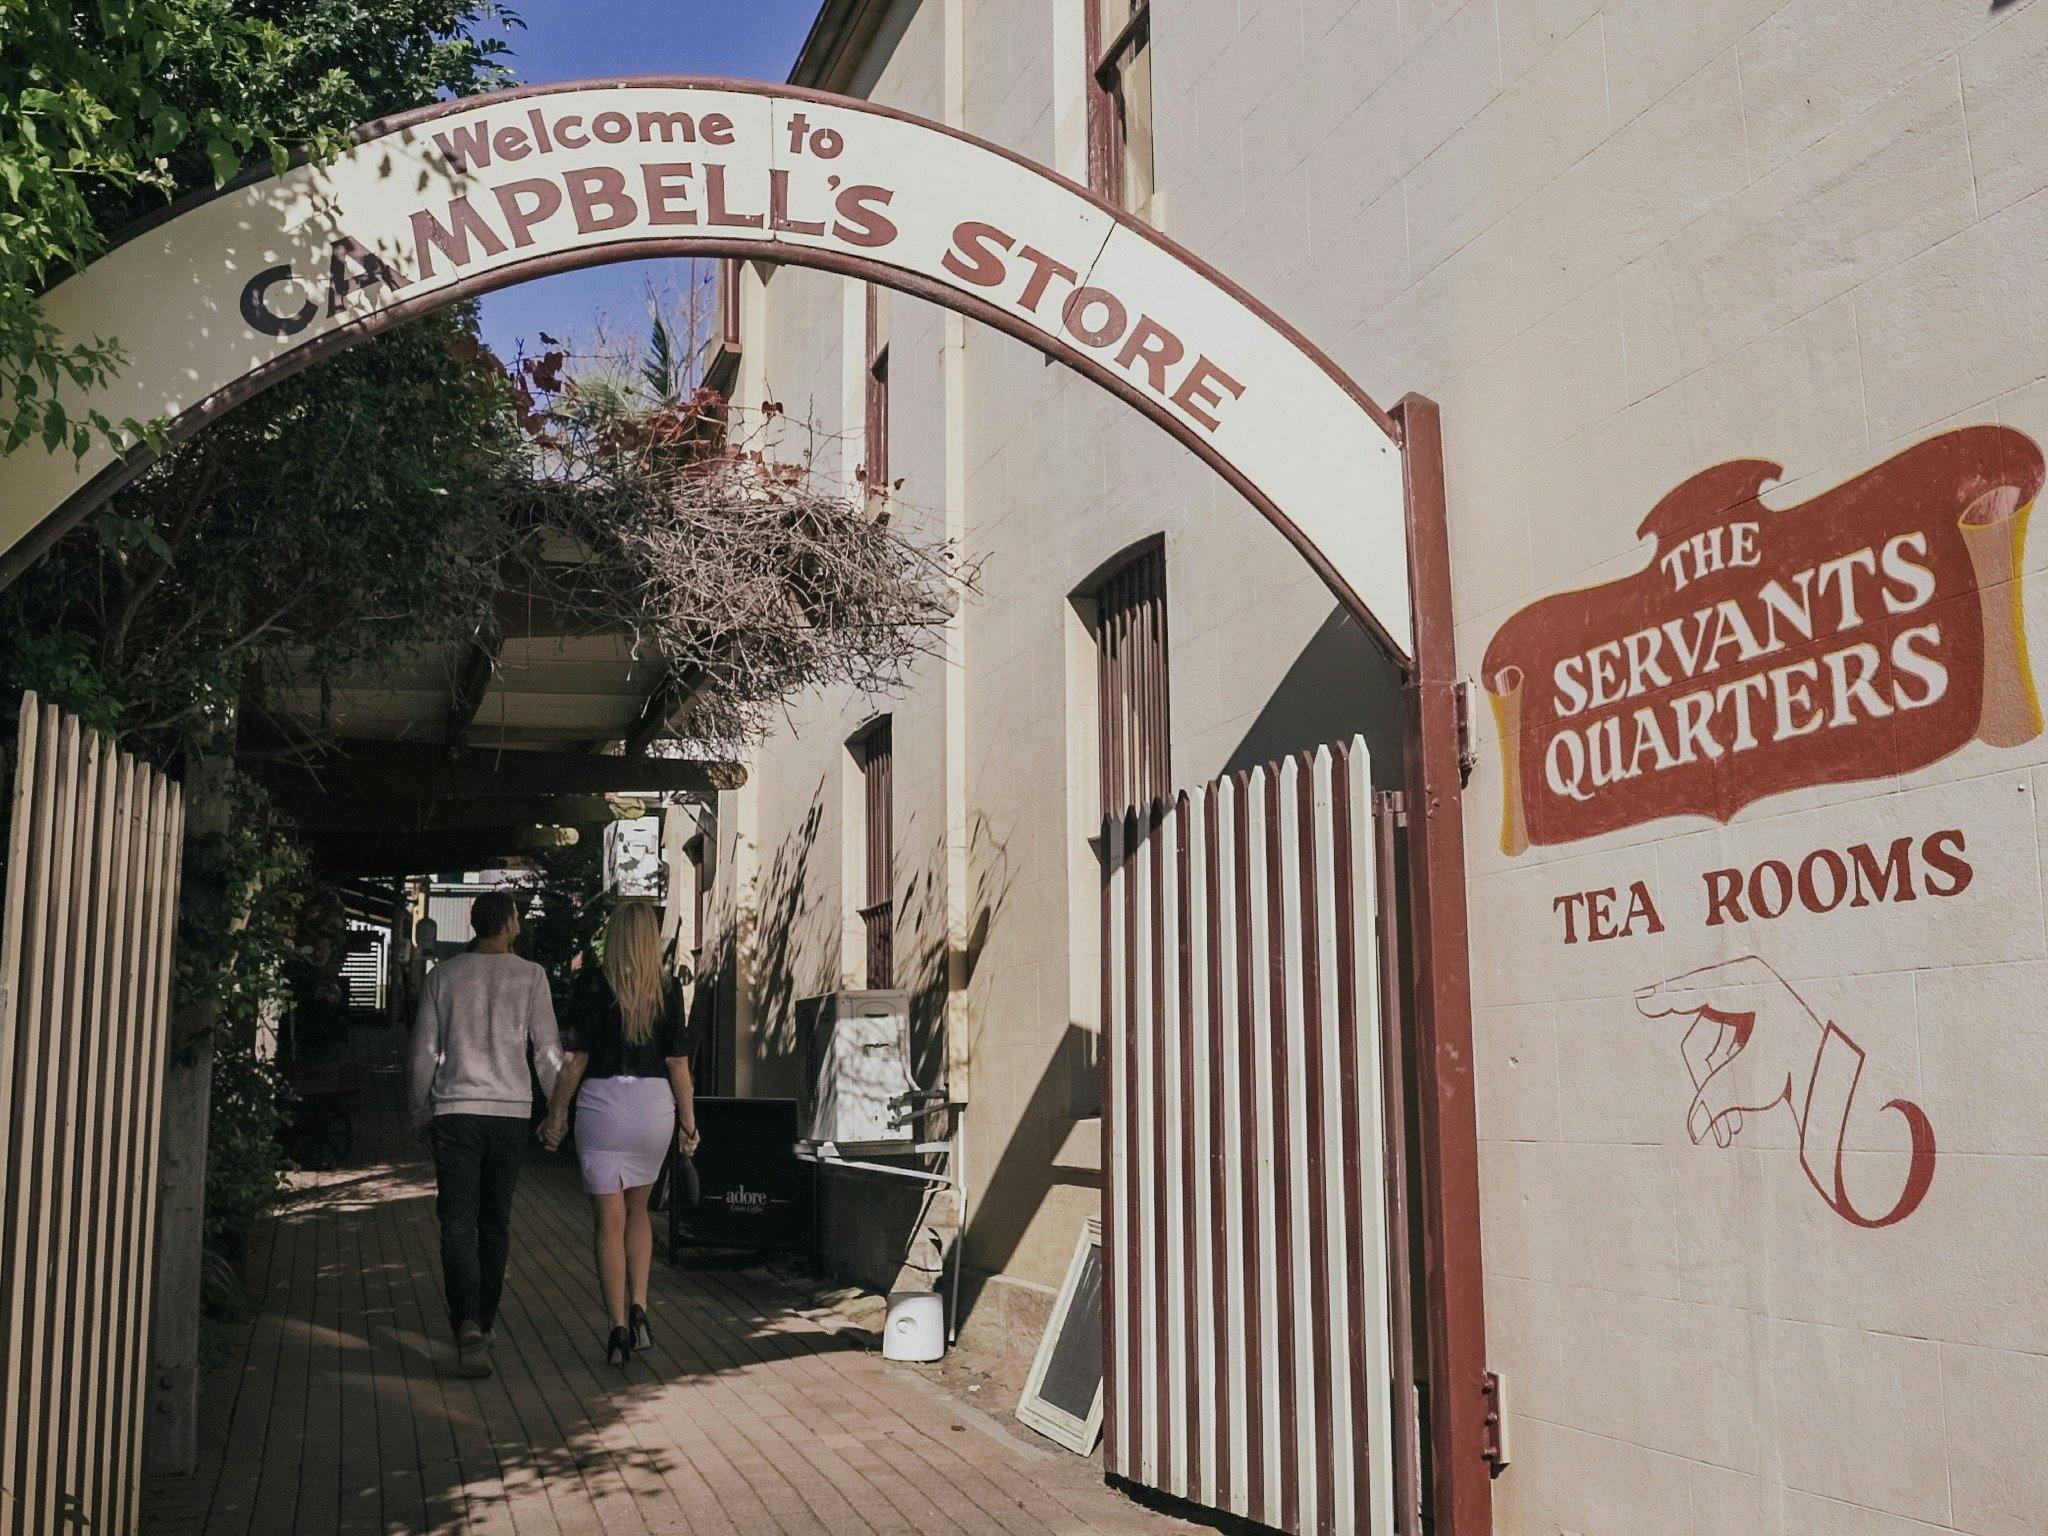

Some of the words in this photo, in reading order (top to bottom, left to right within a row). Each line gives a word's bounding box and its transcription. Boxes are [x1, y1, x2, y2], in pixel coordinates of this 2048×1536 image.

[433, 109, 735, 174] Welcome
[787, 113, 844, 159] to
[239, 163, 898, 336] CAMPBELL'S
[941, 221, 1247, 434] STORE
[1660, 521, 1762, 592] THE
[1552, 531, 1937, 717] SERVANTS
[1544, 623, 1951, 801] QUARTERS
[1553, 880, 1666, 945] TEA
[1702, 829, 1974, 927] ROOMS
[725, 1184, 768, 1205] adore
